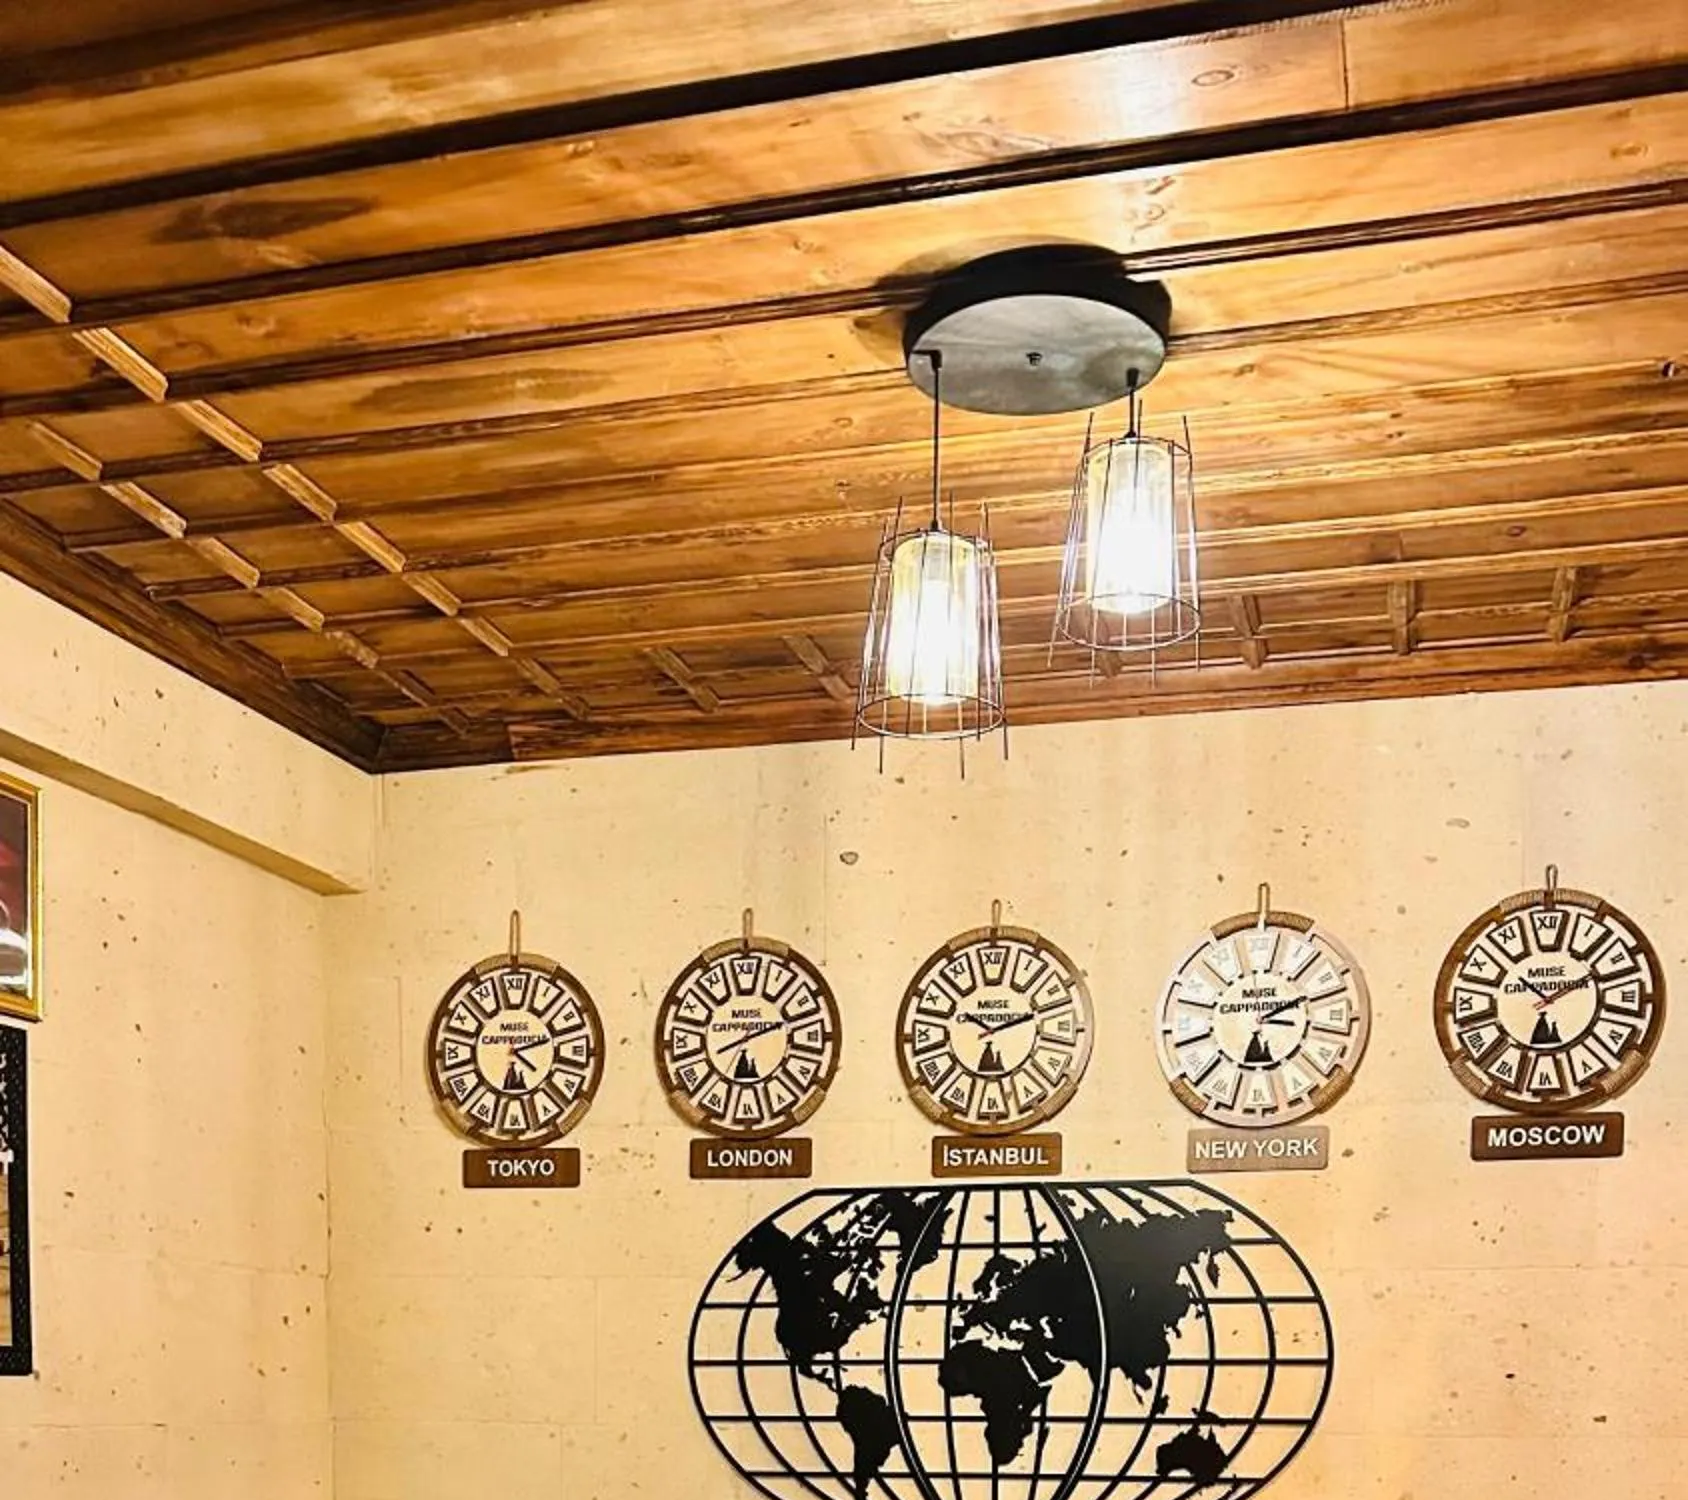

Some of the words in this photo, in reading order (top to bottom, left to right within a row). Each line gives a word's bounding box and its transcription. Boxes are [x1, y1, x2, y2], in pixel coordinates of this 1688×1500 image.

[1538, 916, 1557, 930] XII
[1499, 926, 1516, 944] XI
[1584, 926, 1594, 937] I
[1470, 958, 1486, 971] X
[1611, 952, 1625, 965] II
[1528, 966, 1566, 978] MUSE
[1242, 987, 1277, 998] MUSE
[1621, 990, 1636, 1004] III
[978, 1000, 1009, 1009] MUSE
[1460, 996, 1472, 1011] IX
[731, 1008, 761, 1018] MUSE
[1609, 1029, 1622, 1044] IV
[1582, 1061, 1592, 1074] V
[1539, 1072, 1550, 1086] VI
[1488, 1125, 1604, 1148] MOSCOW
[1195, 1142, 1246, 1159] NEW
[1254, 1138, 1318, 1157] YORK
[707, 1150, 792, 1167] LONDON
[943, 1146, 1048, 1166] İSTANBUL
[488, 1160, 555, 1177] TOKYO
